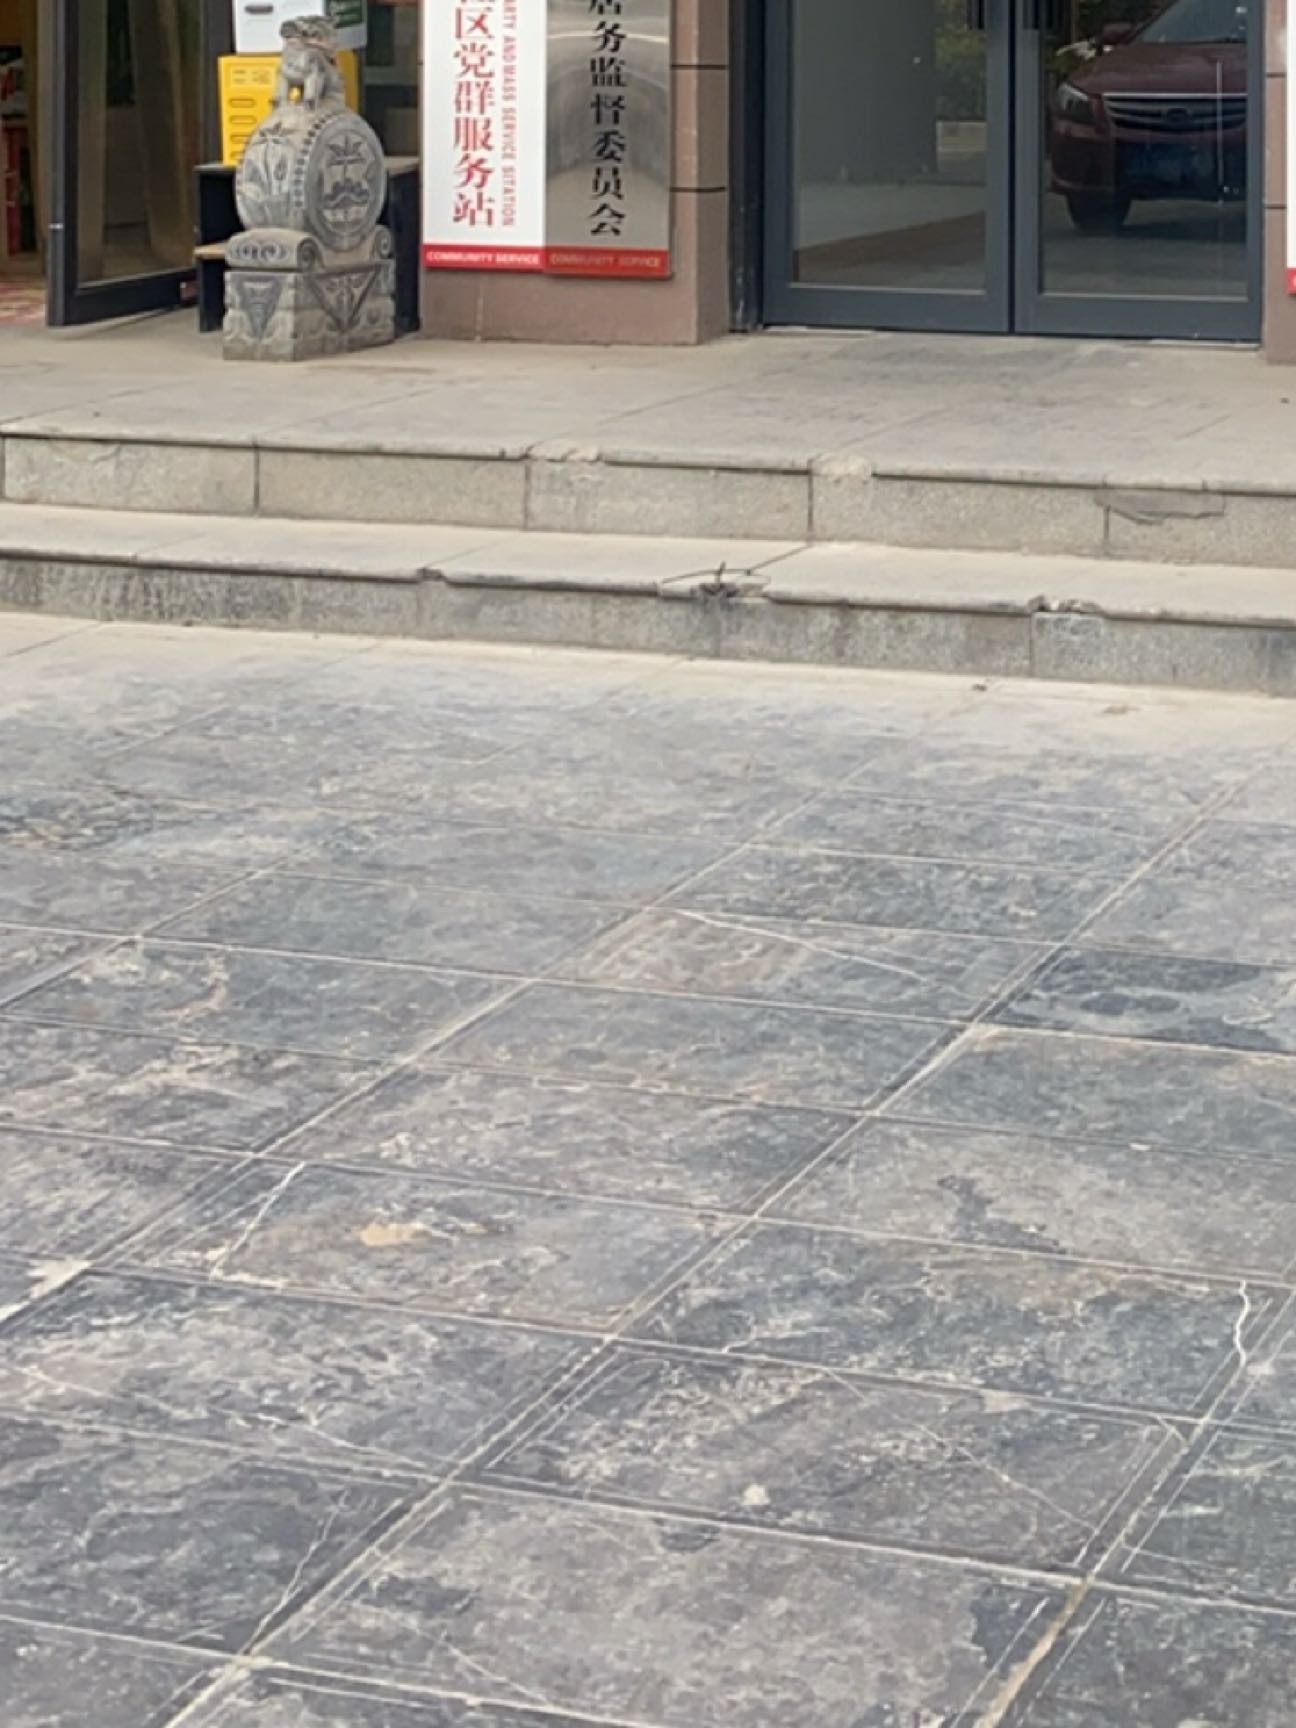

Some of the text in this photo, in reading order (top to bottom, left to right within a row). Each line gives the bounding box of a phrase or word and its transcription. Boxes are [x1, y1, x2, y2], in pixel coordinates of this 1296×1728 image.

[501, 106, 517, 161] SERVICE
[426, 251, 540, 265] COMMUNITY SERVICE
